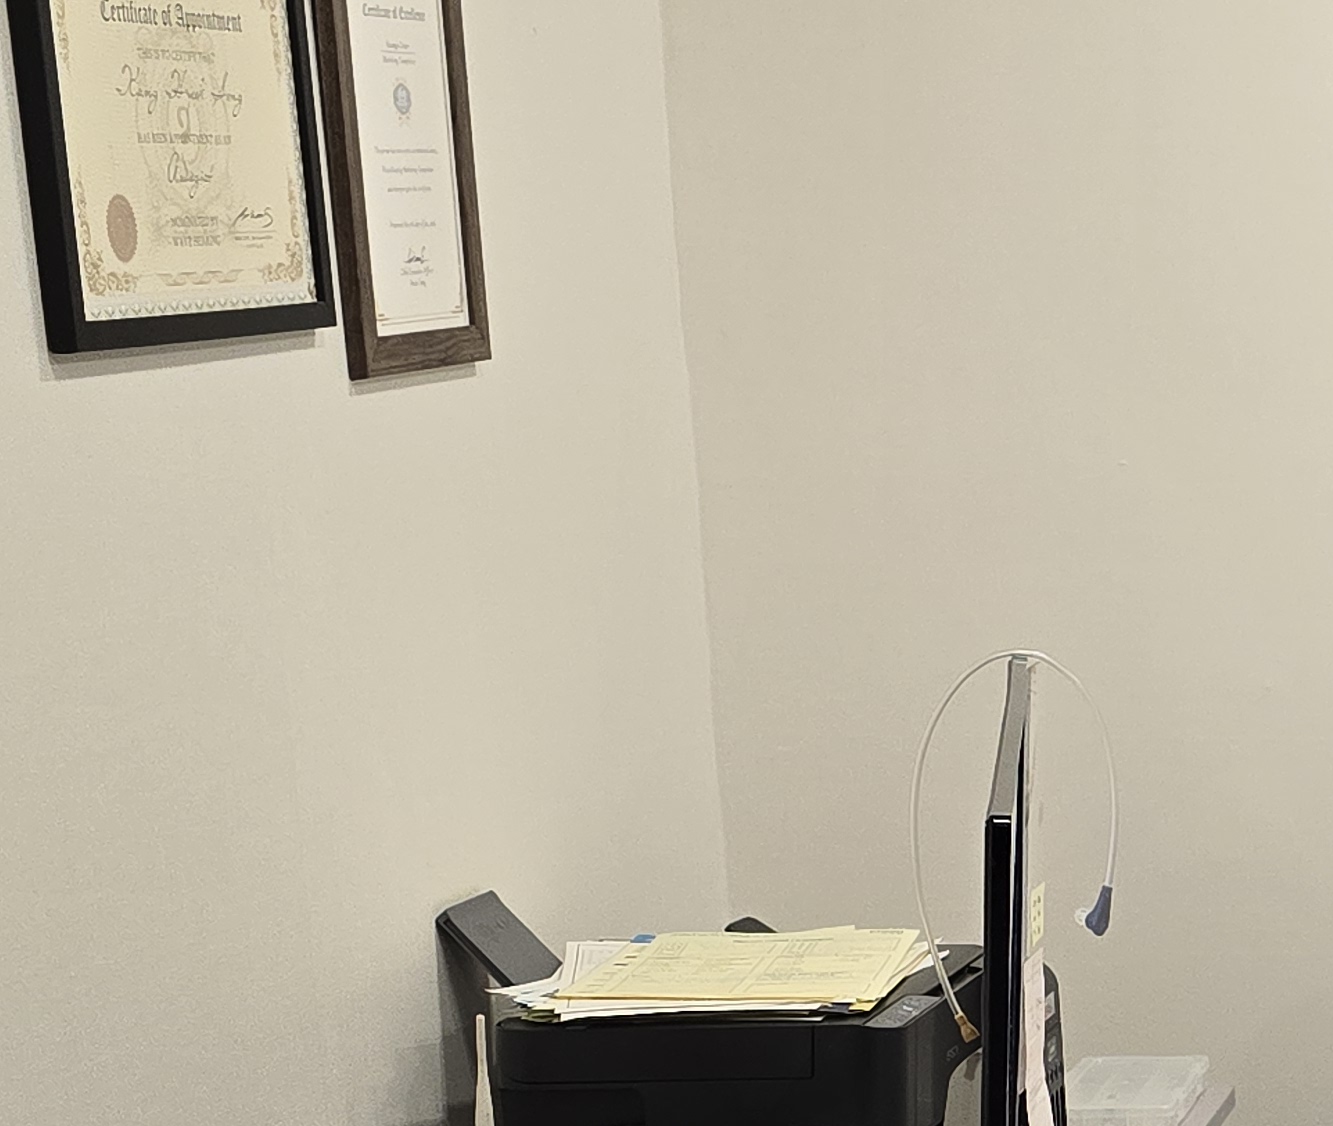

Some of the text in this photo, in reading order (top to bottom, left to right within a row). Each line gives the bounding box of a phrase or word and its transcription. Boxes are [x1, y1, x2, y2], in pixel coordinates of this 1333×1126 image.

[101, 0, 243, 33] Certificate of Appointment
